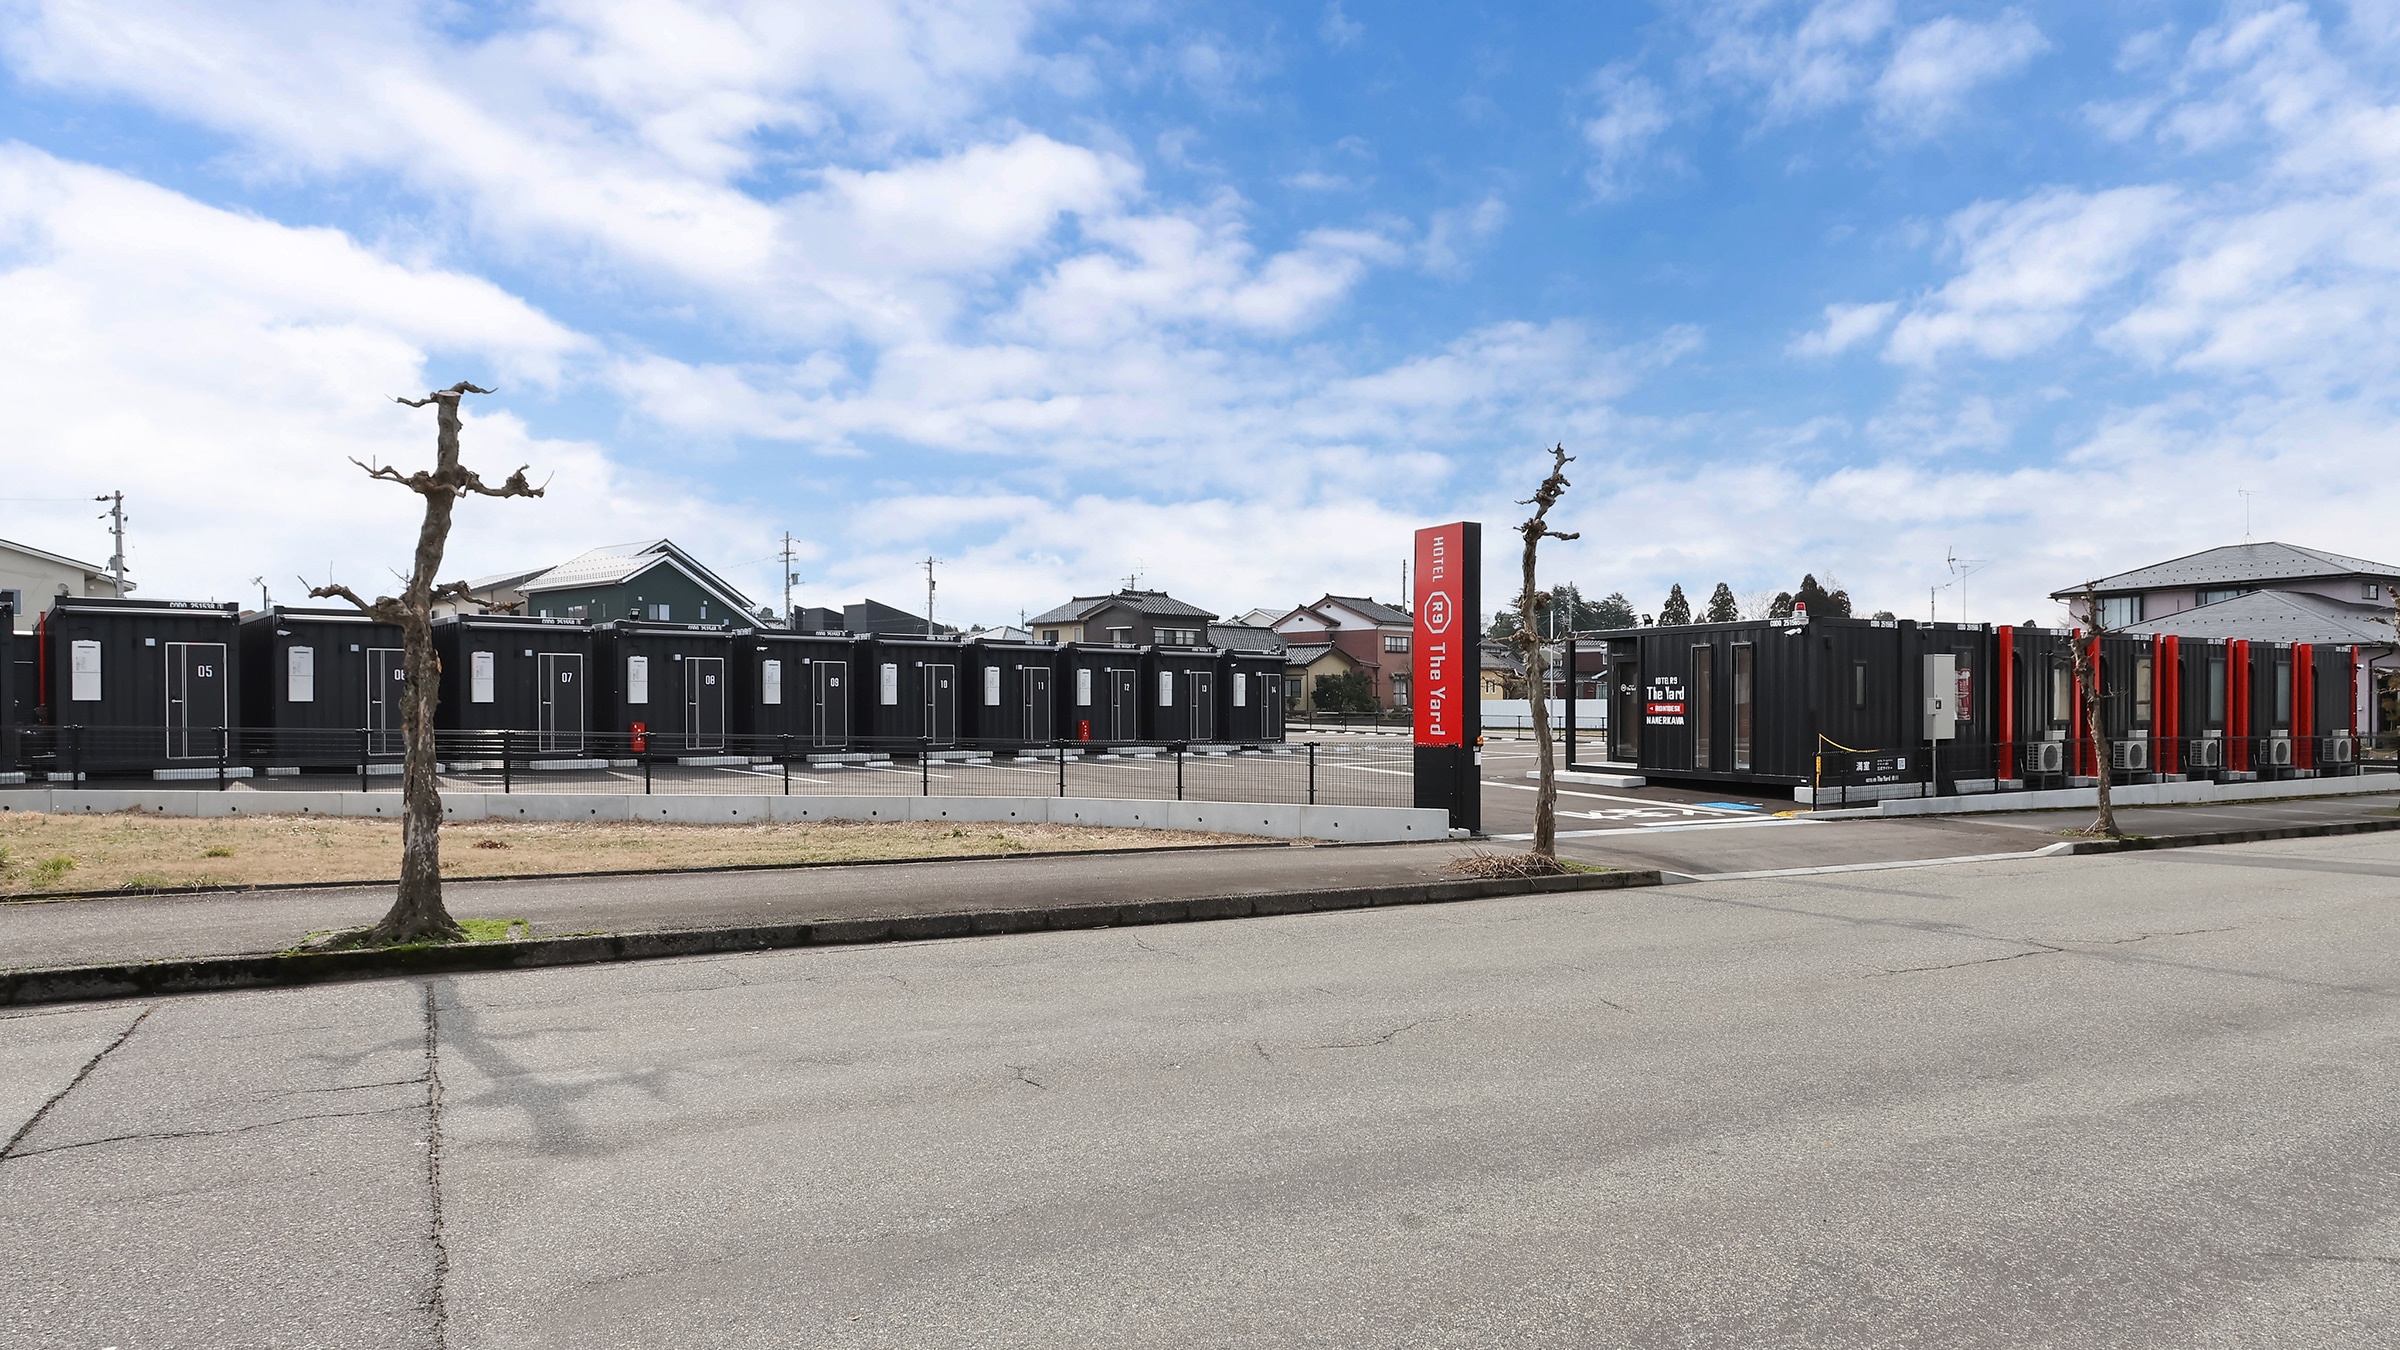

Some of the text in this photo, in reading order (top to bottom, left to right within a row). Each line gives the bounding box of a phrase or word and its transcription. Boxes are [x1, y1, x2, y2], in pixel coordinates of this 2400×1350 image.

[1429, 536, 1446, 735] HOTEL R9 The Yard
[197, 665, 213, 677] 05
[561, 672, 573, 683] 07
[705, 675, 716, 685] 08
[830, 677, 840, 687] 09
[1670, 677, 1678, 685] R9
[940, 680, 948, 689] 10
[1037, 682, 1044, 690] 11
[1124, 683, 1130, 692] 12
[1201, 684, 1208, 693] 13
[1646, 686, 1663, 700] The
[1665, 686, 1685, 700] Yard
